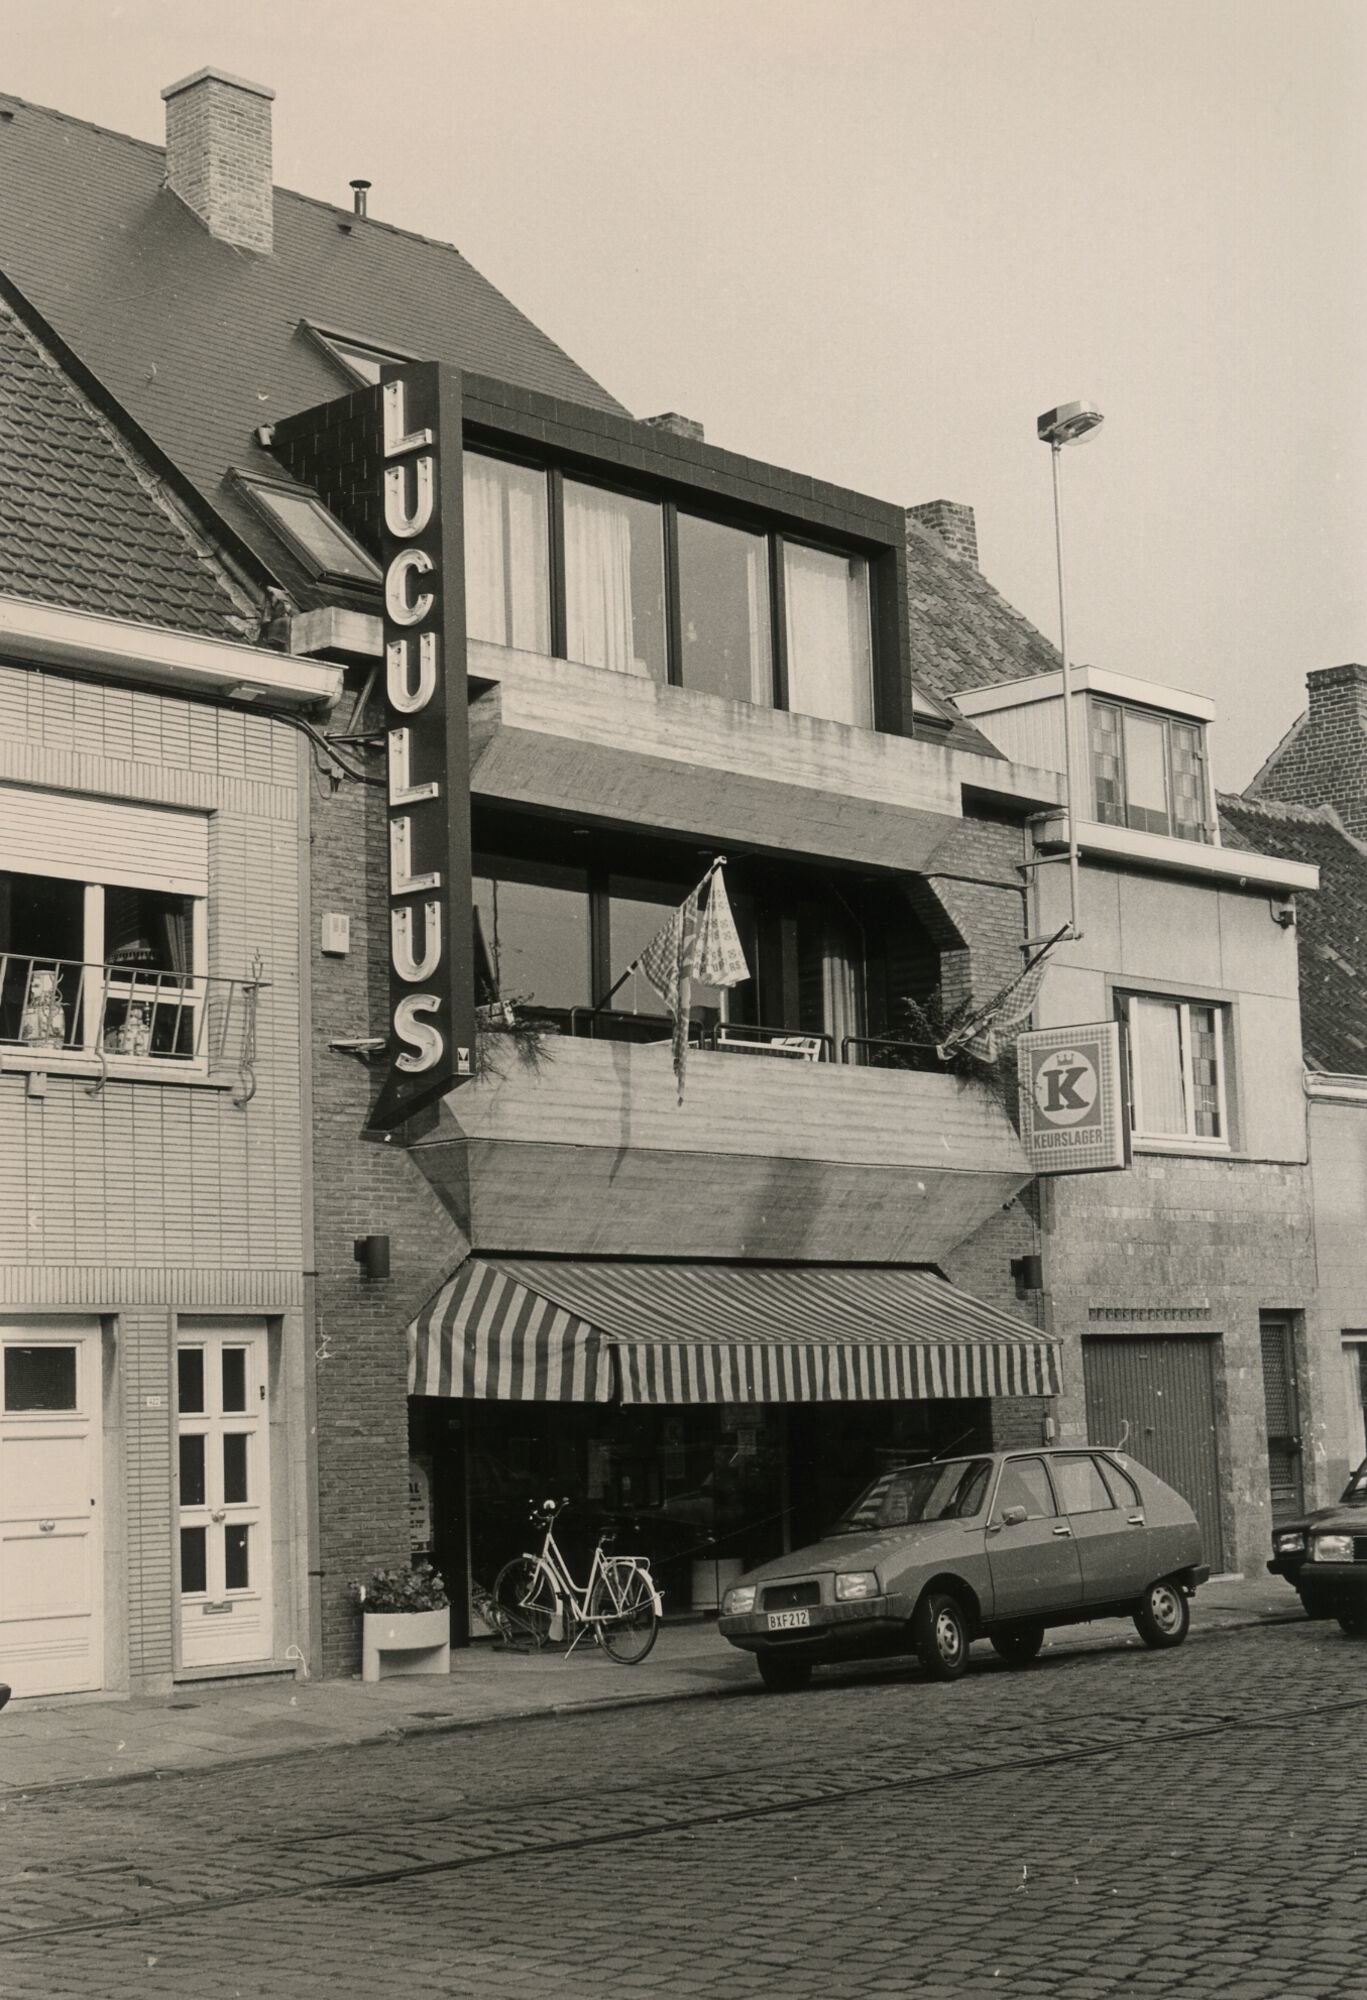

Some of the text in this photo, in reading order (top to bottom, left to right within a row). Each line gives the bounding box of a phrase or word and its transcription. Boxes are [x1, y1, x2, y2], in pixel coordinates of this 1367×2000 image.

[383, 380, 443, 1072] LUCULLUS
[1042, 1067, 1090, 1112] K
[1034, 1129, 1103, 1149] KEURSLAGER
[770, 1612, 807, 1628] BXF212
